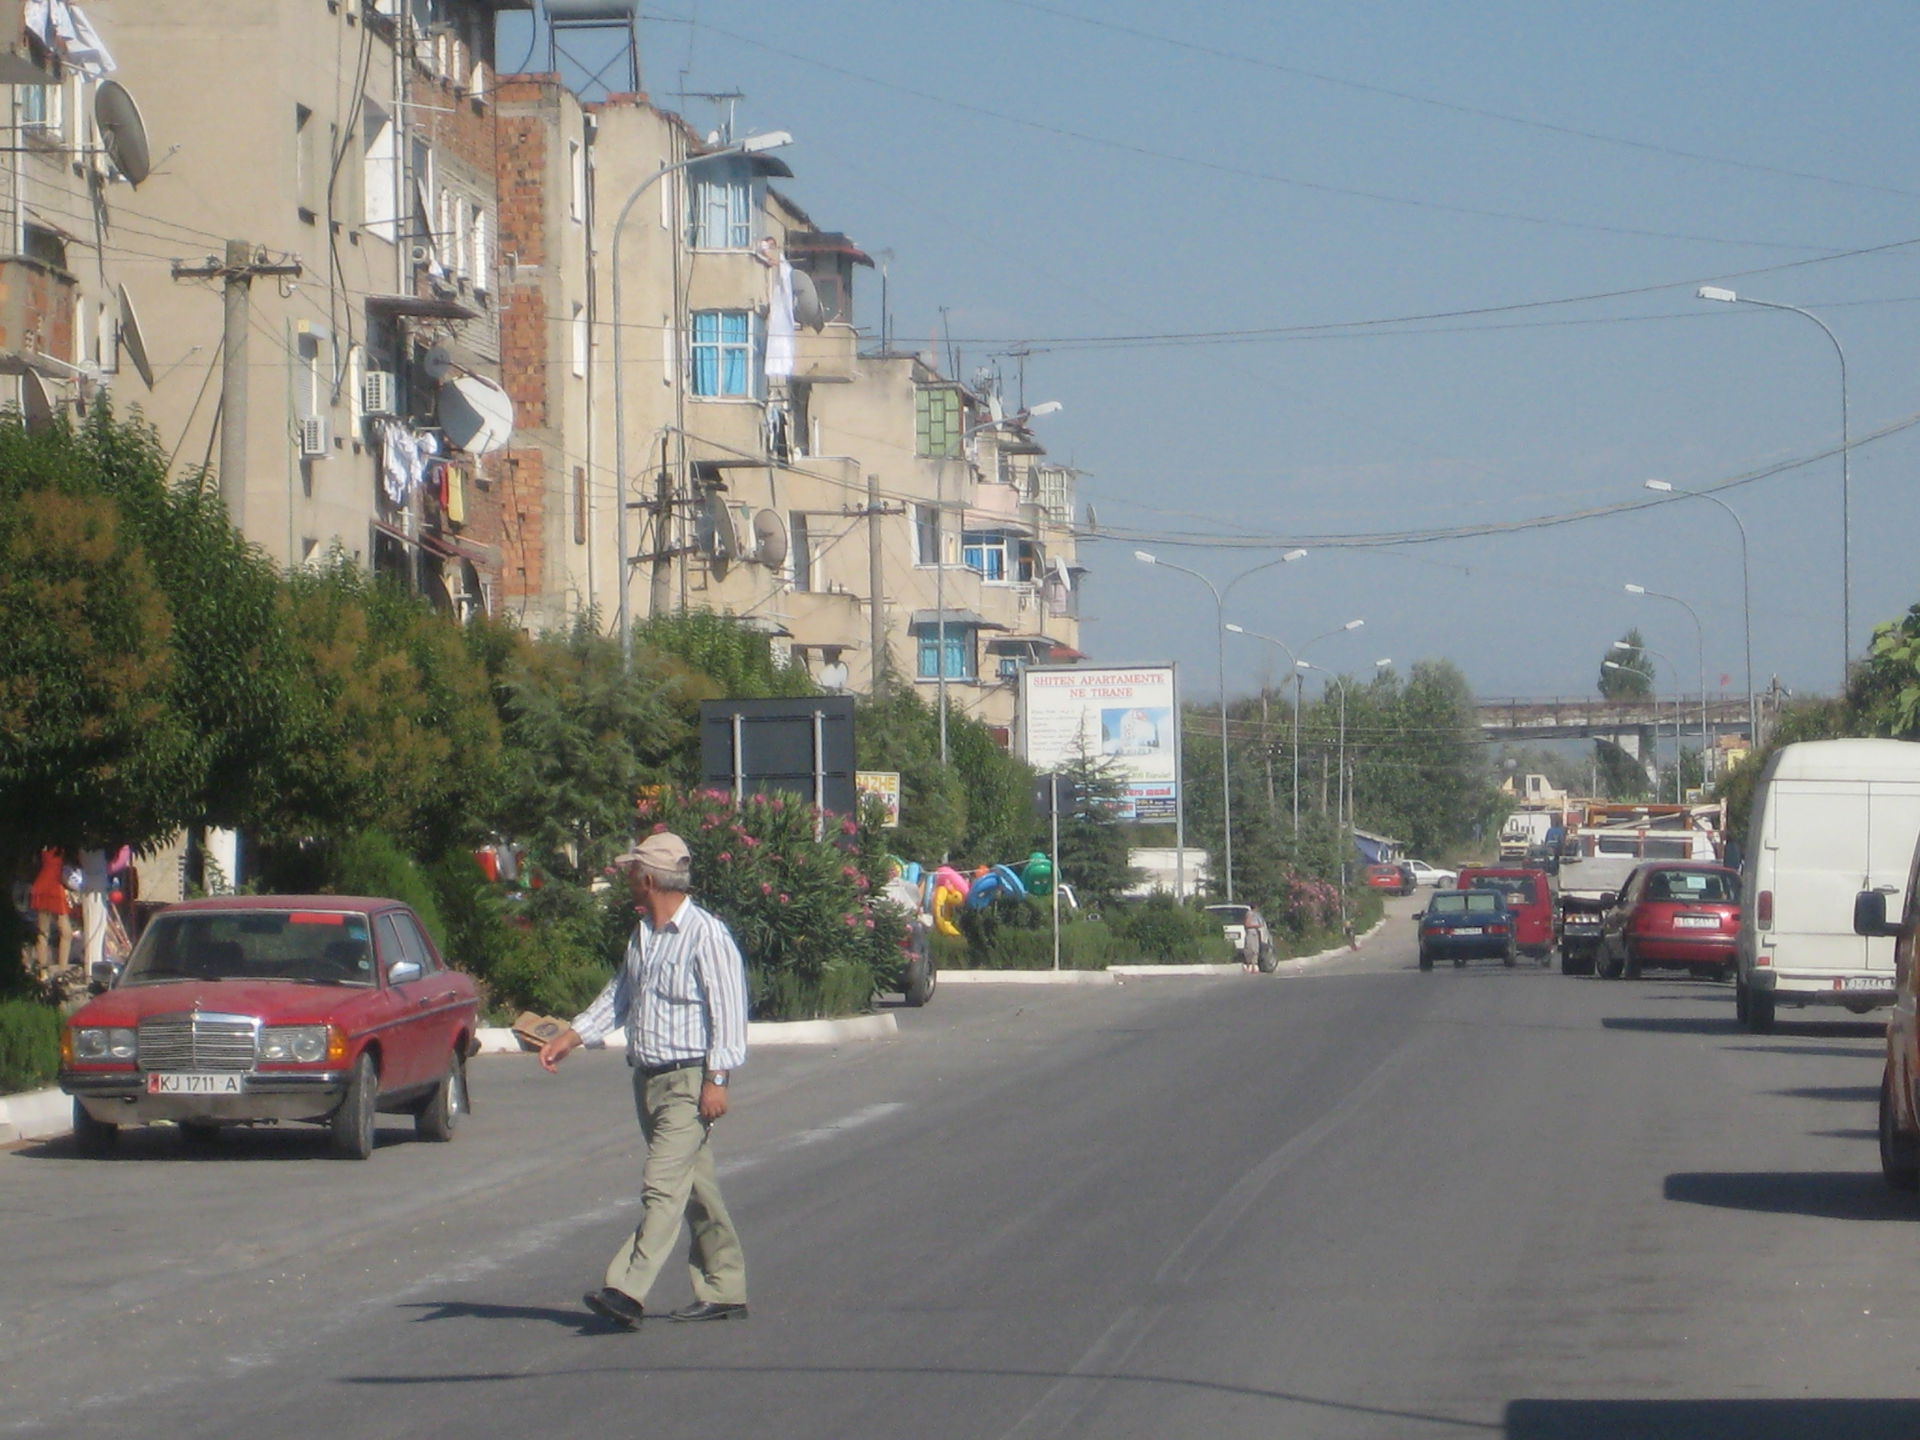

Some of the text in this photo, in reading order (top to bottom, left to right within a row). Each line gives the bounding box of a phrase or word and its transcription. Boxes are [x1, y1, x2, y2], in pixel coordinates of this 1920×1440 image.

[1033, 673, 1164, 686] SHITEN APARTAMENTE
[1070, 687, 1133, 698] NE TIRANE
[160, 1076, 237, 1091] KJ 1711 A
